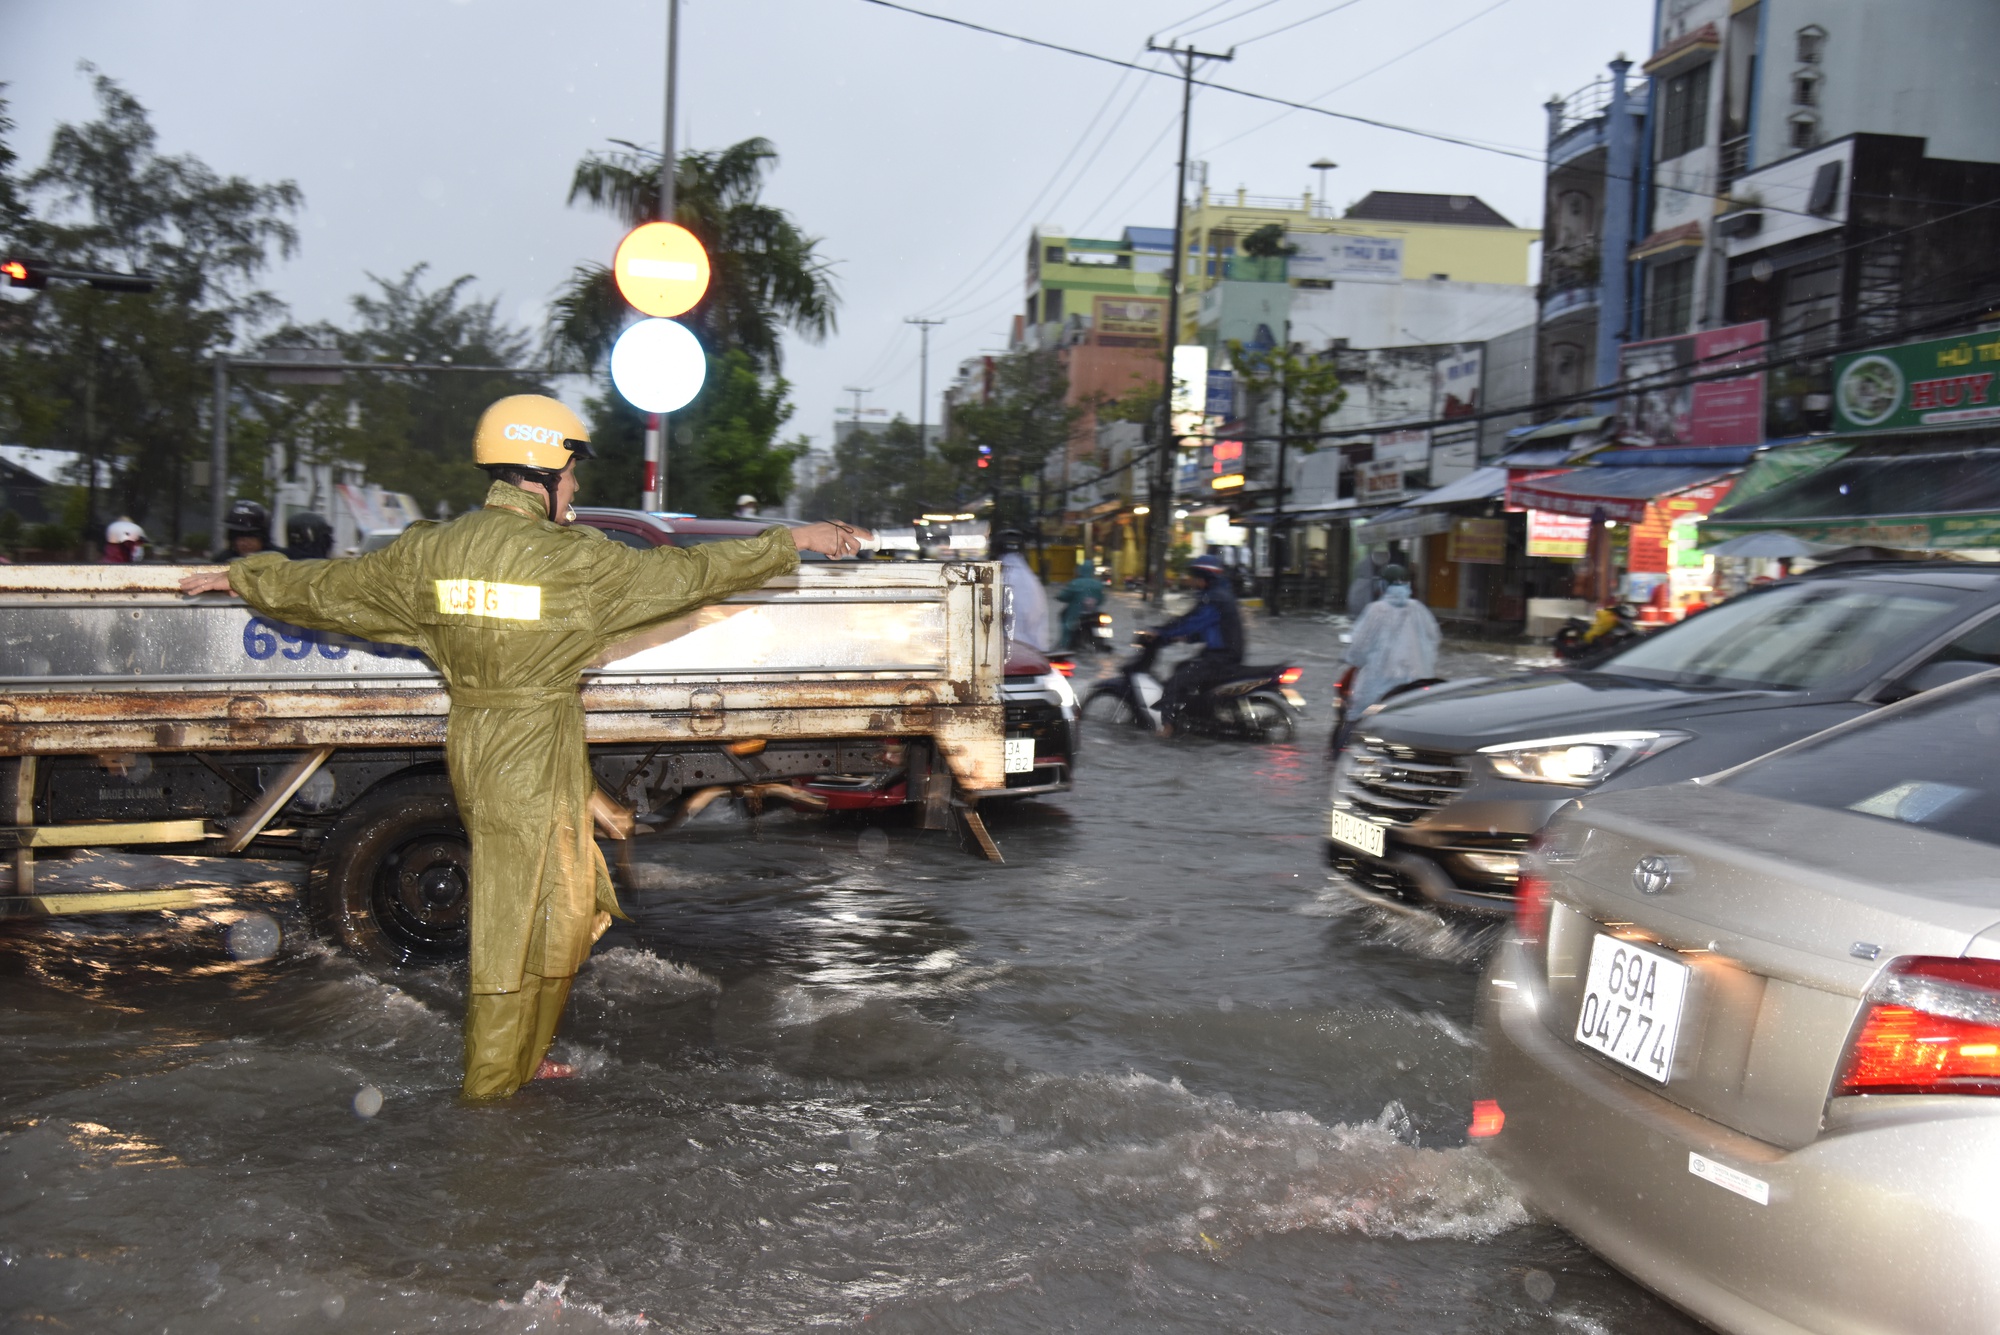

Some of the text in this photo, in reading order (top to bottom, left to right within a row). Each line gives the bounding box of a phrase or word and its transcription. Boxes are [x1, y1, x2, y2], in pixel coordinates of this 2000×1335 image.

[1910, 373, 1994, 410] HUY
[503, 423, 563, 447] CSGT
[99, 789, 123, 800] MADE
[1608, 948, 1657, 1011] 69A
[1582, 993, 1666, 1074] 047.74
